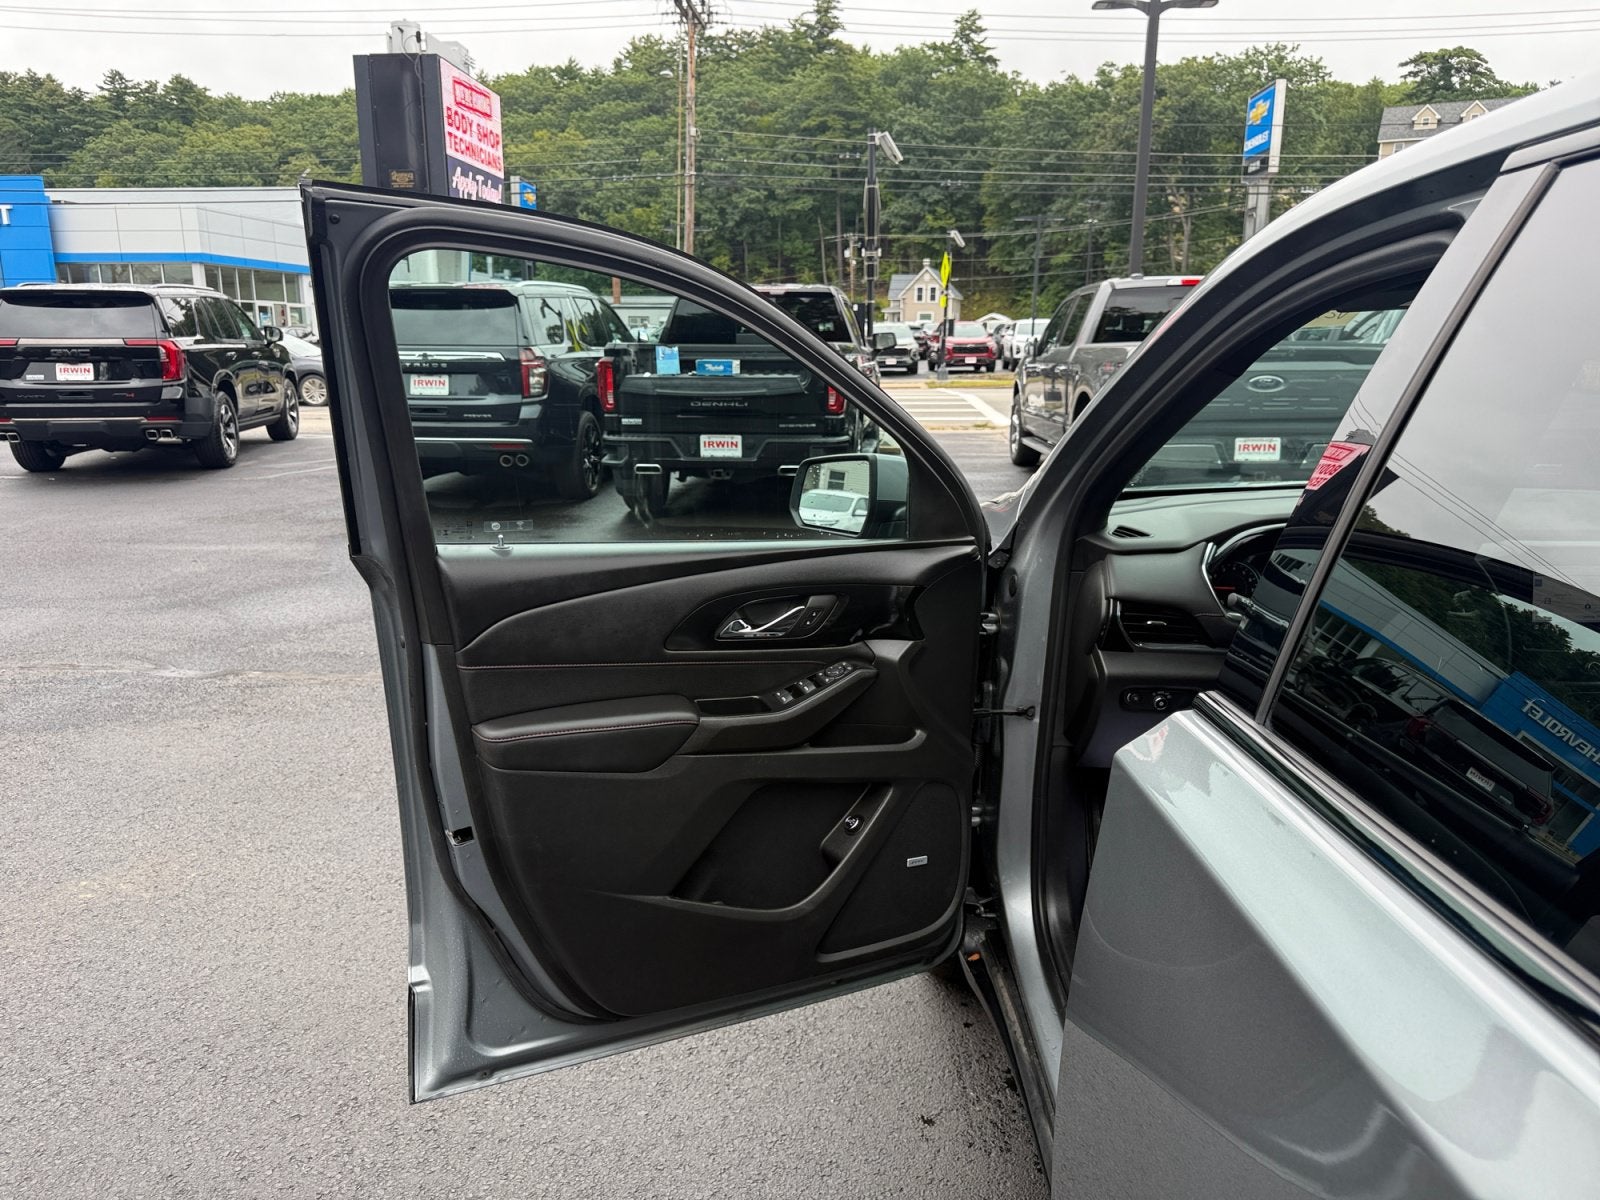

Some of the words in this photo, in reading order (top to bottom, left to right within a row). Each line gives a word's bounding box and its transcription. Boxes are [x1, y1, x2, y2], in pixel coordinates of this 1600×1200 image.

[446, 106, 474, 137] BODY
[476, 123, 500, 151] SHOP
[447, 131, 502, 172] TECHNICIANS
[413, 379, 446, 387] IRWIN
[703, 441, 738, 449] IRWIN
[1238, 443, 1277, 453] IRWIN
